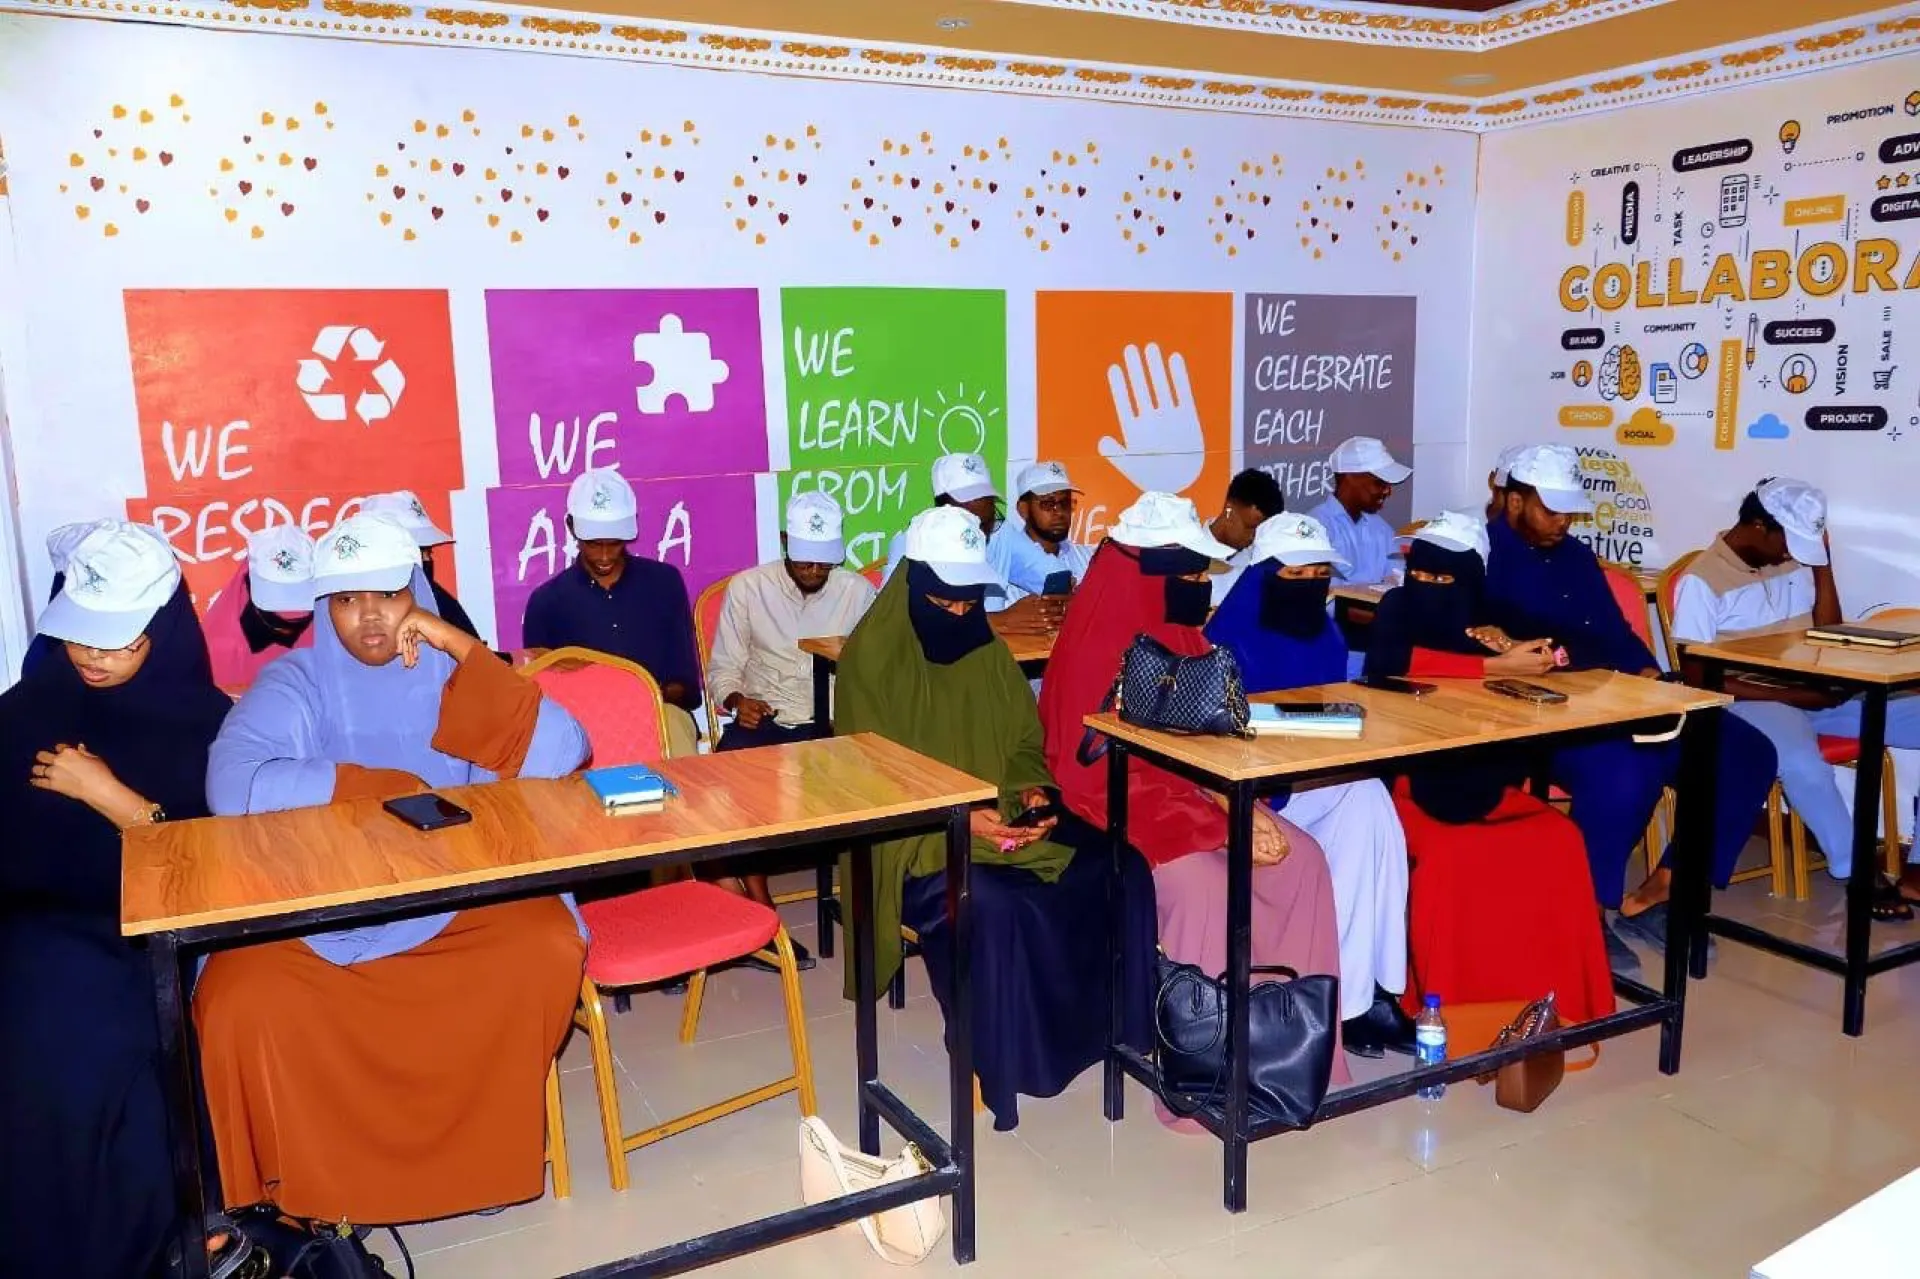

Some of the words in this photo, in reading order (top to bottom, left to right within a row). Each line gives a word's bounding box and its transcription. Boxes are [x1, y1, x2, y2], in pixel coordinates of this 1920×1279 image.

[1827, 104, 1894, 125] PROMOTION
[1590, 164, 1631, 178] CREATIVE
[1682, 146, 1749, 166] LEADERSHIP
[1625, 191, 1635, 237] MEDIA
[1673, 211, 1684, 246] TASK
[1256, 297, 1297, 337] WE
[1643, 322, 1697, 334] COMMUNITY
[1775, 327, 1823, 338] SUCCESS
[794, 326, 856, 378] WE
[1568, 335, 1598, 346] BRAND
[1881, 330, 1893, 362] SALE
[1254, 352, 1393, 392] CELEBRATE
[1835, 344, 1849, 396] VISION
[1719, 346, 1736, 443] COLLABORATION
[799, 398, 920, 452] LEARN
[1254, 408, 1325, 447] EACH
[1623, 430, 1657, 440] SOCIAL
[1820, 413, 1876, 425] PROJECT
[161, 419, 253, 481] WE
[528, 411, 621, 479] WE
[1259, 461, 1336, 499] THER
